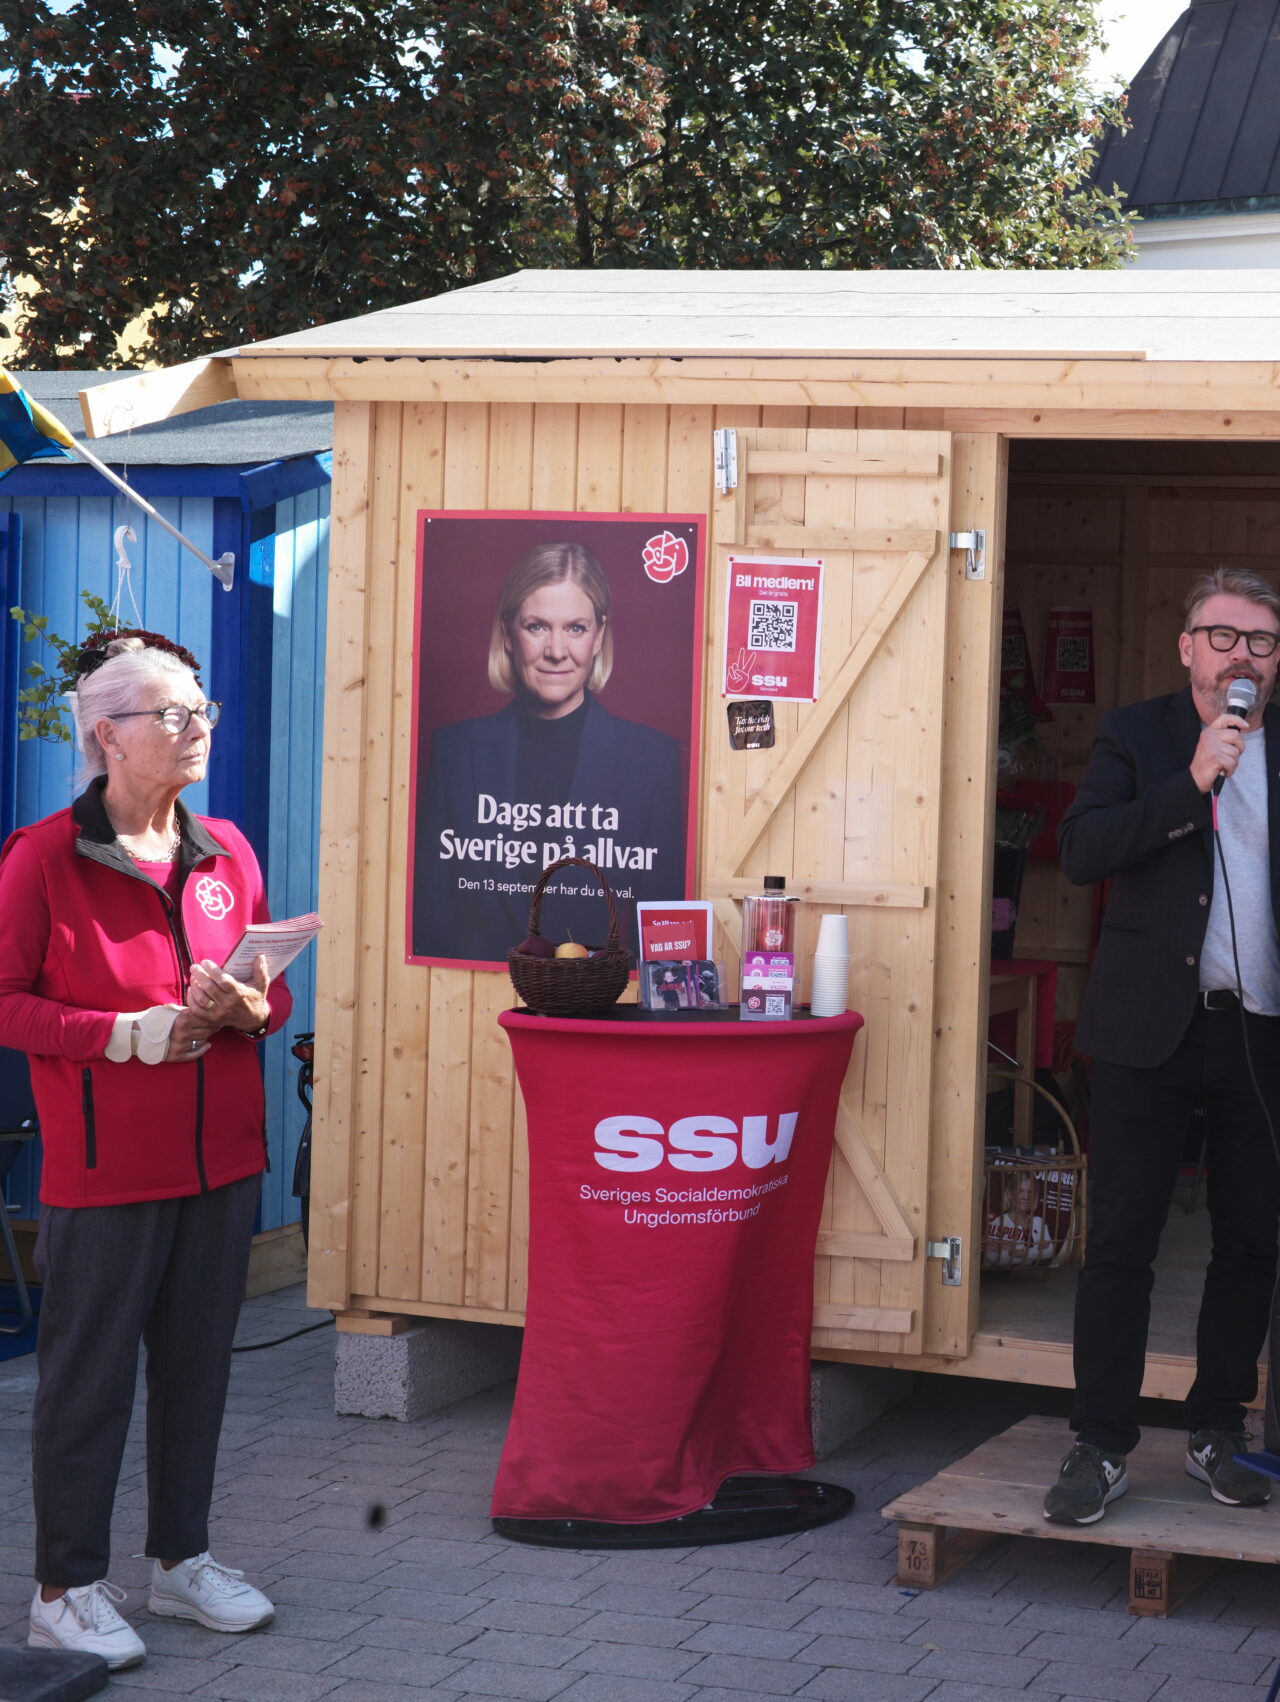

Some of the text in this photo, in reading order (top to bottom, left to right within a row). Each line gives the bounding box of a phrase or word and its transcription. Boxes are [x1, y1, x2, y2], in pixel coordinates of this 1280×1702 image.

[754, 577, 814, 591] medlem!
[477, 793, 620, 832] Dags att ta
[439, 829, 658, 871] Sverige på allvar
[458, 878, 480, 891] Den
[482, 879, 495, 892] 13
[560, 882, 578, 896] har
[580, 884, 594, 896] du
[616, 886, 635, 898] val.
[650, 943, 663, 952] VAD
[674, 940, 692, 950] SSU?
[580, 1174, 789, 1207] Sveriges Socialdemokratiska
[624, 1203, 760, 1229] Ungdomsförbund
